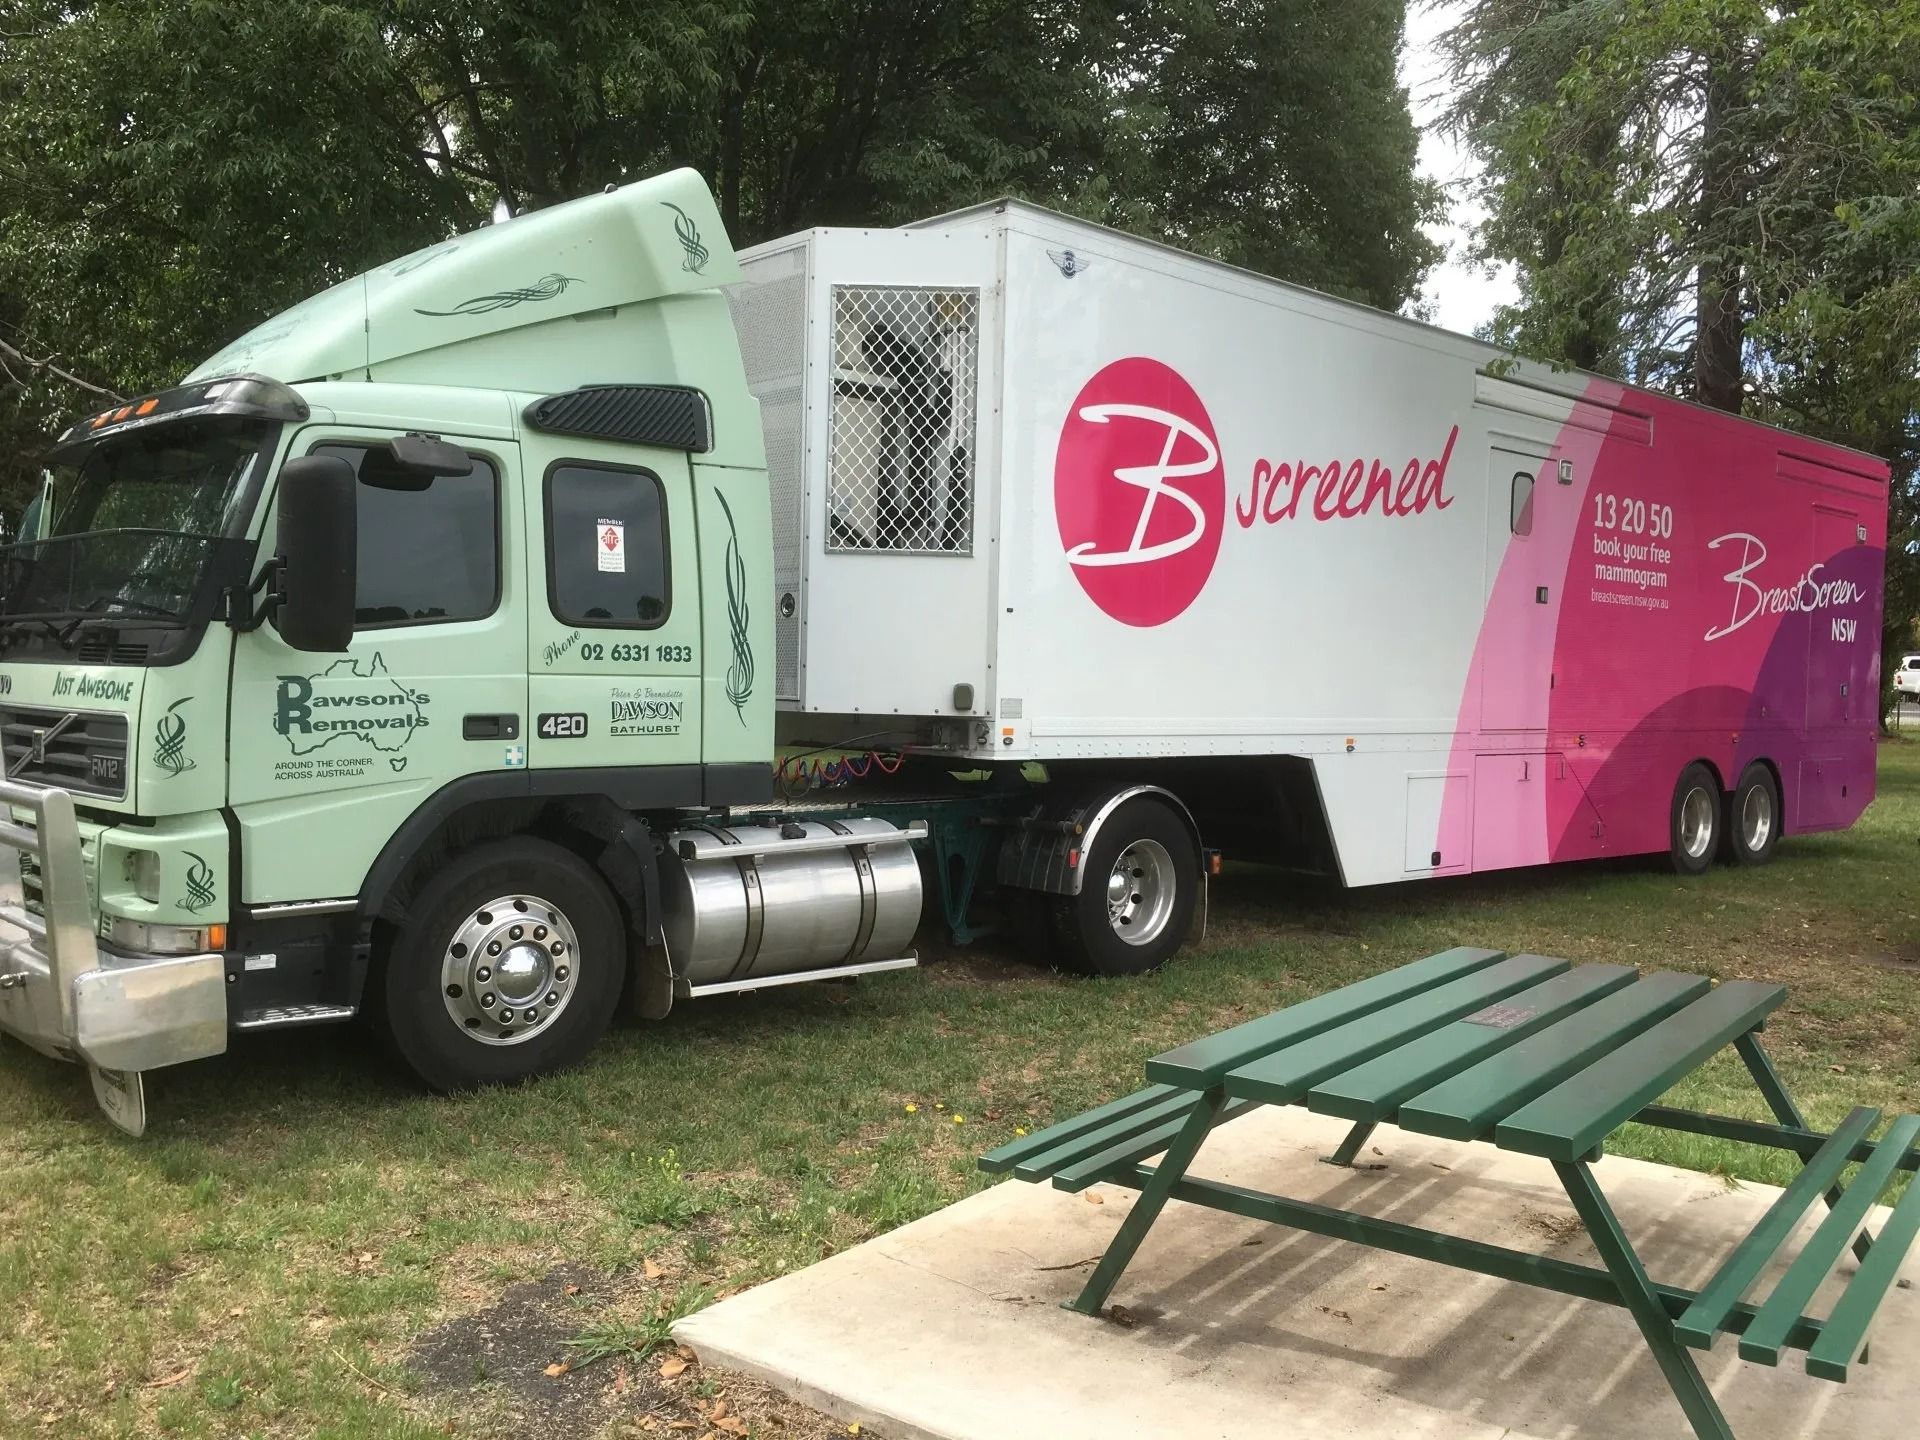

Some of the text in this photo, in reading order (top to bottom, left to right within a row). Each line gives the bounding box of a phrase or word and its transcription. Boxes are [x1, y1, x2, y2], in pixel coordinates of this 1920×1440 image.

[1065, 403, 1460, 566] B screened
[1594, 493, 1673, 539] 13 20 50
[1594, 533, 1671, 563] book your free
[1595, 564, 1667, 590] mammogram
[1704, 532, 1867, 641] BreastScreen
[1591, 588, 1669, 610] breastscreen.nsw.gov.au
[1831, 617, 1857, 642] NSW
[543, 630, 692, 667] Phone 02 6331 1833
[634, 688, 642, 699] &
[277, 705, 430, 735] Removals
[611, 700, 683, 723] DAWSON
[543, 716, 585, 736] 420
[610, 725, 680, 734] BATHURST
[92, 758, 118, 779] FM12
[275, 761, 314, 770] AROUND
[316, 760, 334, 768] THE
[275, 768, 365, 780] ACROSS AUSTRALIA
